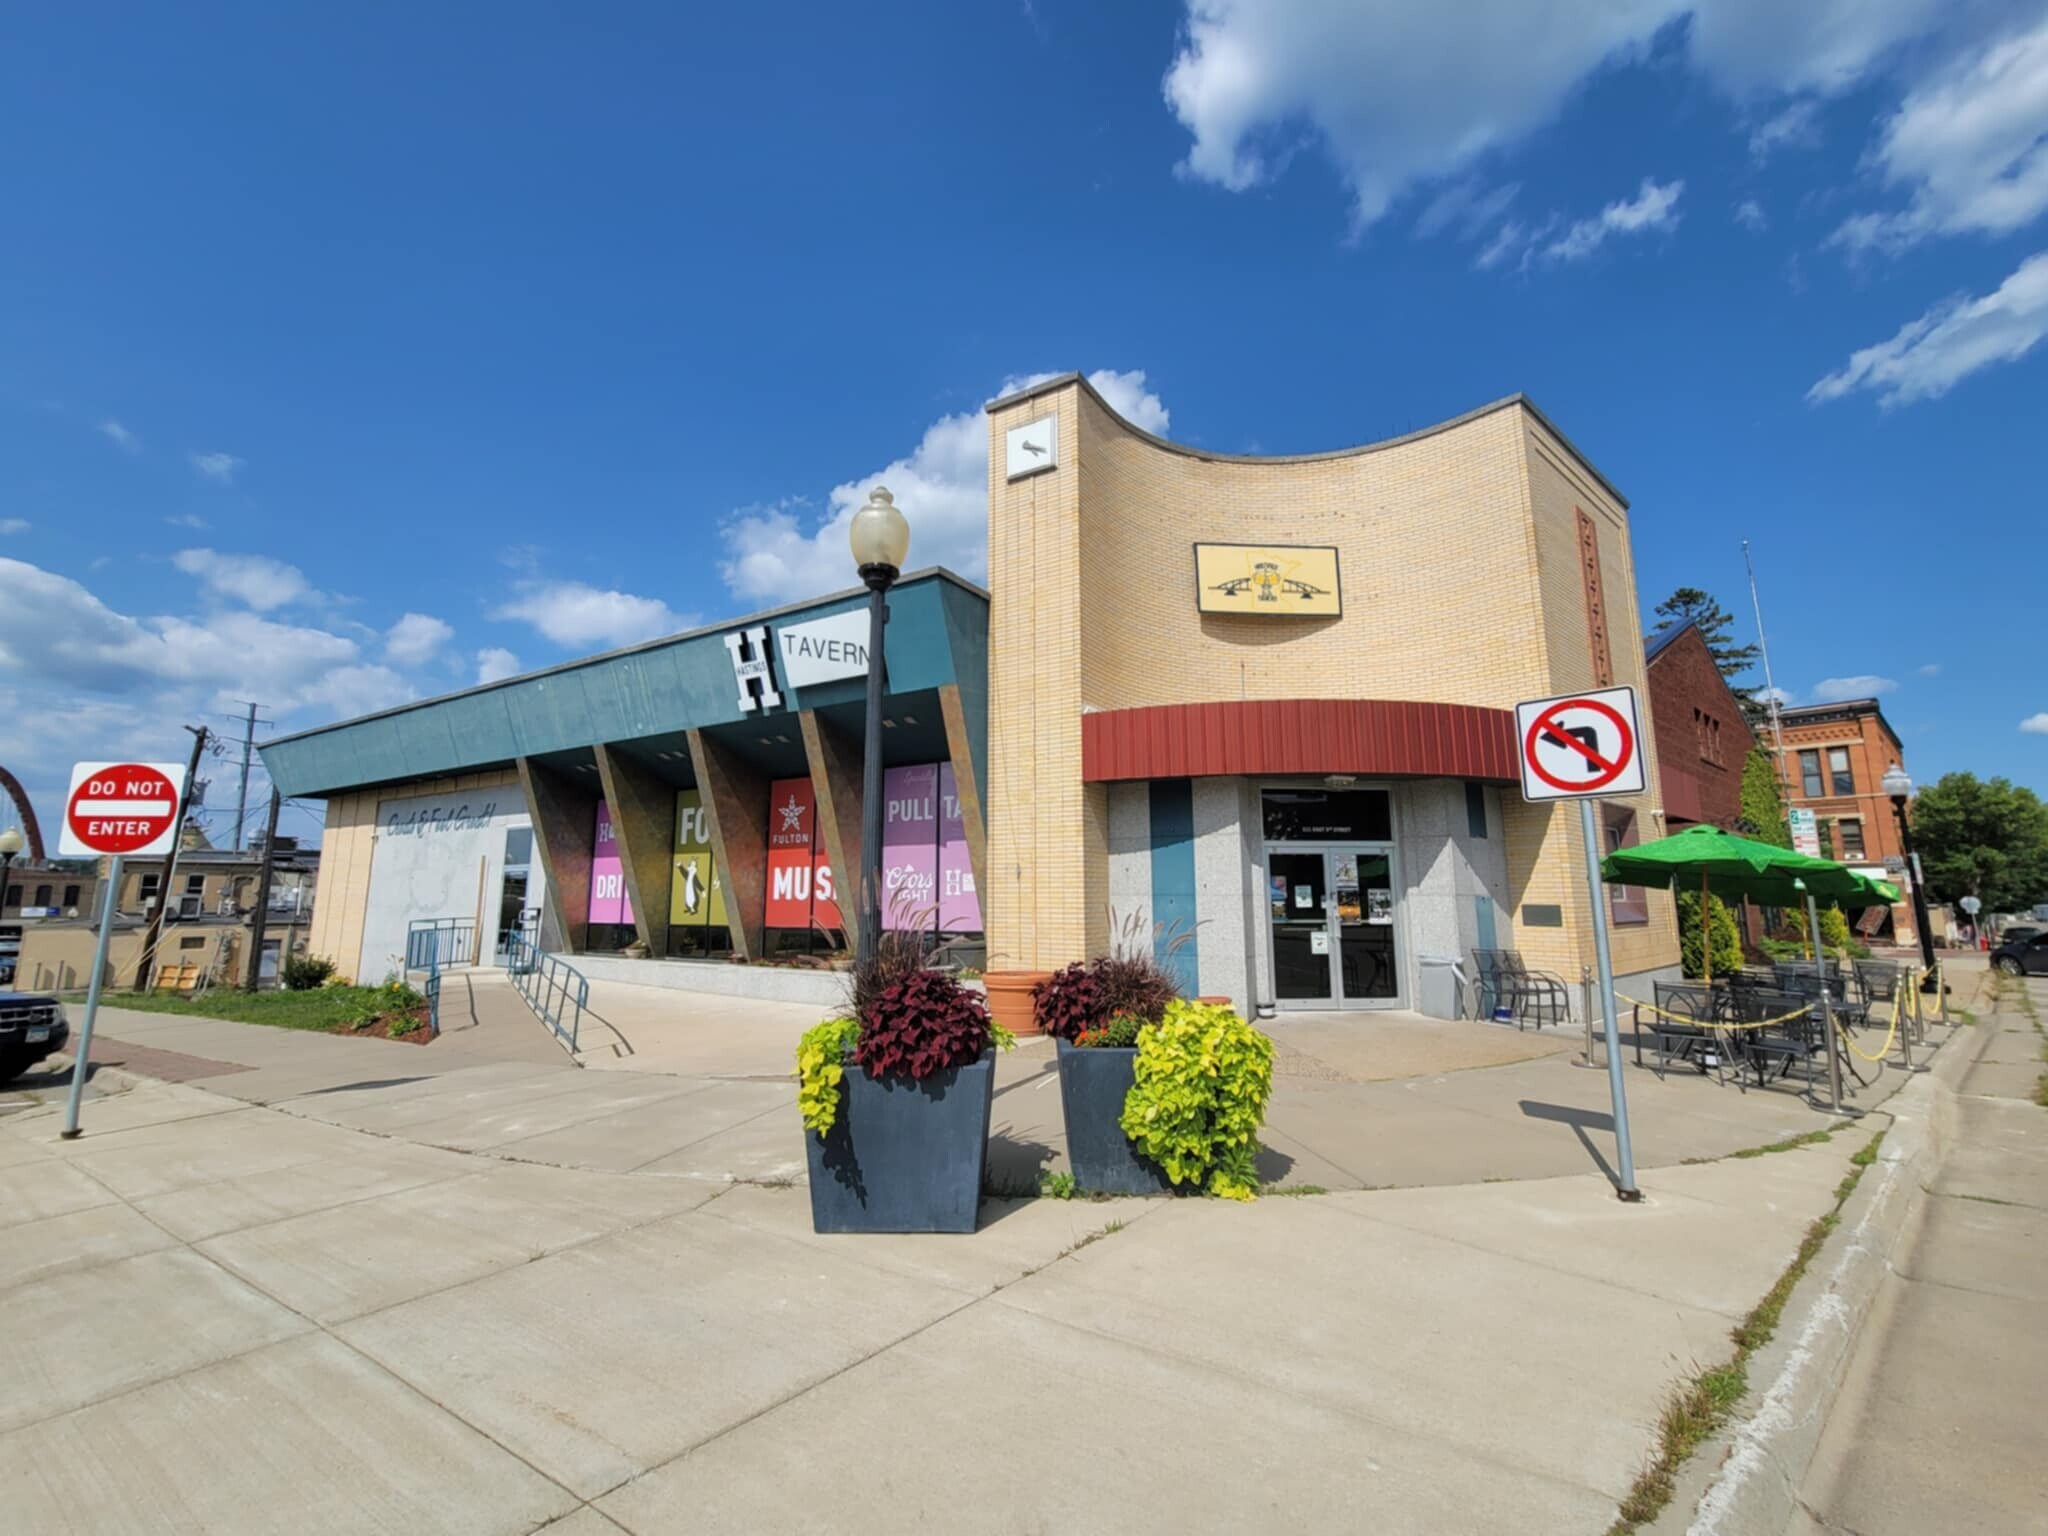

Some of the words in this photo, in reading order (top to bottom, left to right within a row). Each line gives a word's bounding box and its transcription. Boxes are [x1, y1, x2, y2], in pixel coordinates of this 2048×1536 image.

[783, 634, 870, 667] TAVERN
[723, 626, 781, 712] H
[736, 661, 767, 676] HASTINGS
[88, 780, 116, 796] DO
[125, 780, 165, 796] NOT
[887, 797, 934, 823] PULL
[87, 821, 151, 836] ENTER
[772, 833, 809, 844] FULTON
[596, 874, 629, 899] DRI
[773, 865, 838, 901] MUS
[886, 866, 934, 889] Coors
